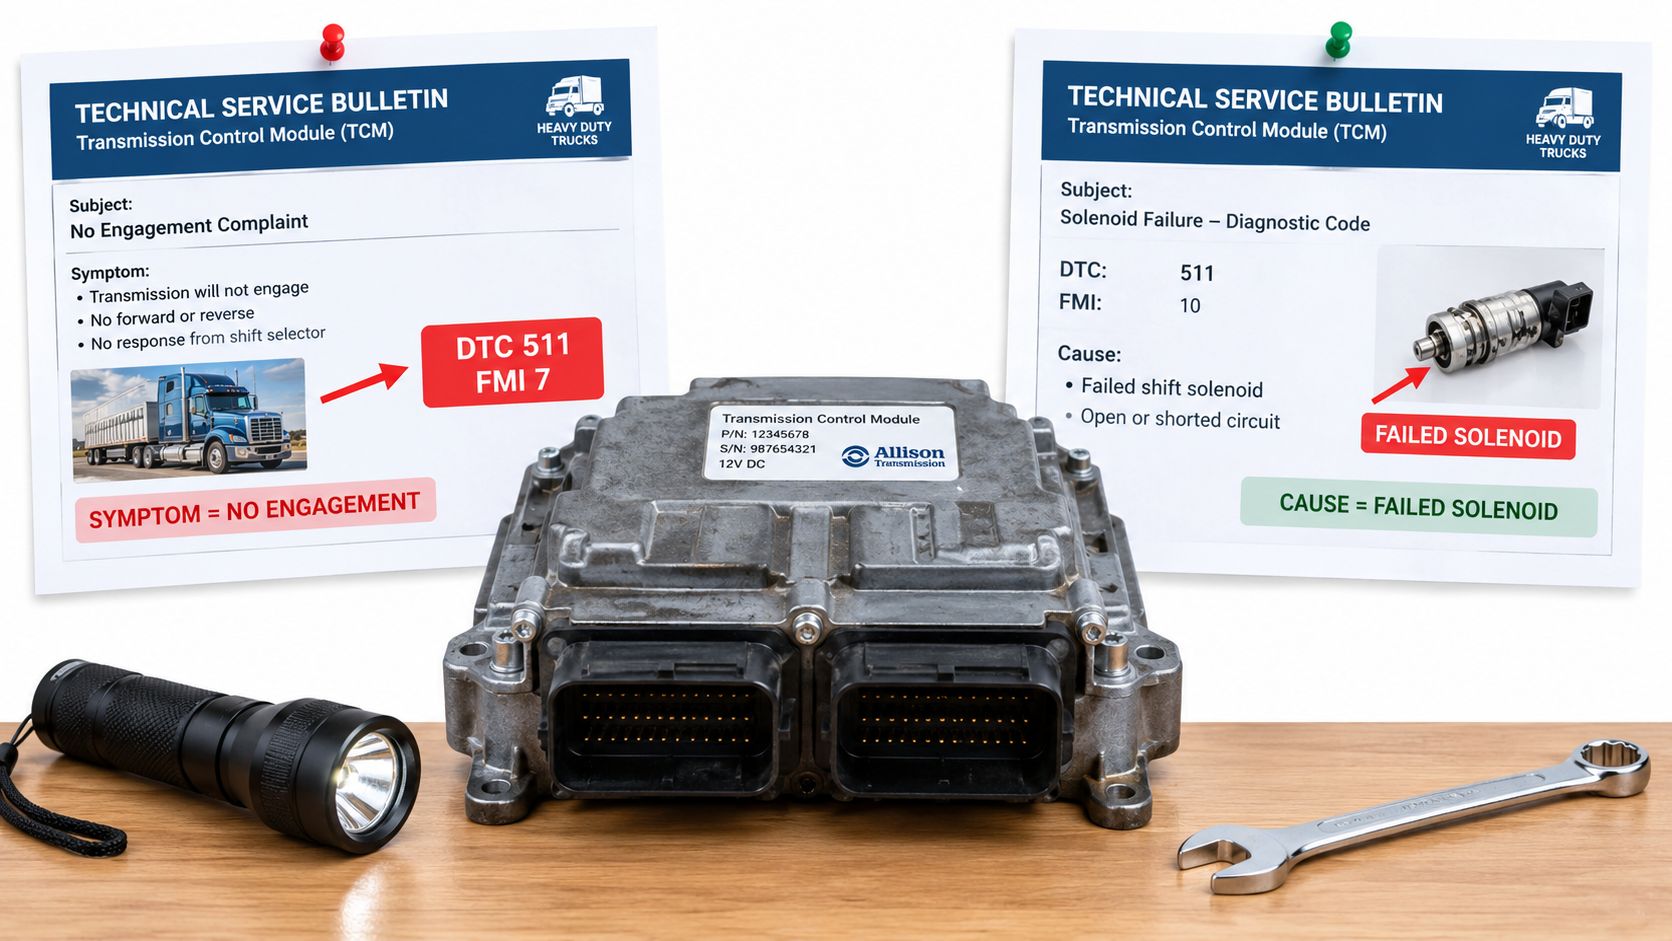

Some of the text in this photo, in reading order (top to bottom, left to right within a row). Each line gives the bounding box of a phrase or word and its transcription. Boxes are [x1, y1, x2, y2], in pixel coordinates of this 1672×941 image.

[75, 88, 447, 123] TECHNICAL SERVICE BULLETIN
[1068, 85, 1442, 113] TECHNICAL SERVICE BULLETIN
[76, 121, 393, 150] Transmission Control Module (TCM)
[538, 121, 612, 133] HEAVY DUTY
[1068, 118, 1386, 143] Transmission Control Module (TCM)
[551, 135, 598, 145] TRUCKS
[1527, 134, 1601, 145] HEAVY DUTY
[1540, 148, 1586, 158] TRUCKS
[1061, 182, 1131, 201] Subject:
[70, 198, 132, 215] Subject:
[71, 214, 308, 240] No Engagement Complaint
[1061, 209, 1137, 226] Solenoid
[1144, 211, 1203, 227] Failure
[1227, 213, 1319, 233] Diagnostic
[1326, 216, 1370, 231] Code
[72, 267, 149, 283] Symptom:
[1061, 261, 1212, 281] DTC: 511
[89, 283, 309, 303] Transmission will not engage
[1060, 293, 1200, 313] FMI: 10
[91, 309, 254, 327] No forward or reverse
[92, 327, 326, 351] No response from shift selector
[457, 332, 568, 360] DTC 511
[1058, 345, 1120, 362] Cause:
[477, 368, 550, 393] FMI 7
[1083, 377, 1262, 398] Failed shift solenoid
[723, 414, 920, 424] Transmission Control Module
[1081, 408, 1280, 429] Open or shorted circuit
[722, 430, 809, 438] P/N: 12345678
[1376, 425, 1562, 448] FAILED SOLENOID
[720, 444, 815, 453] S/N: 987654321
[874, 446, 945, 458] Allison
[720, 459, 765, 468] 12V DC
[874, 459, 945, 467] Transmission
[90, 492, 420, 528] SYMPTOM = NO ENGAGEMENT
[1280, 493, 1558, 520] CAUSE = FAILED SOLENOID
